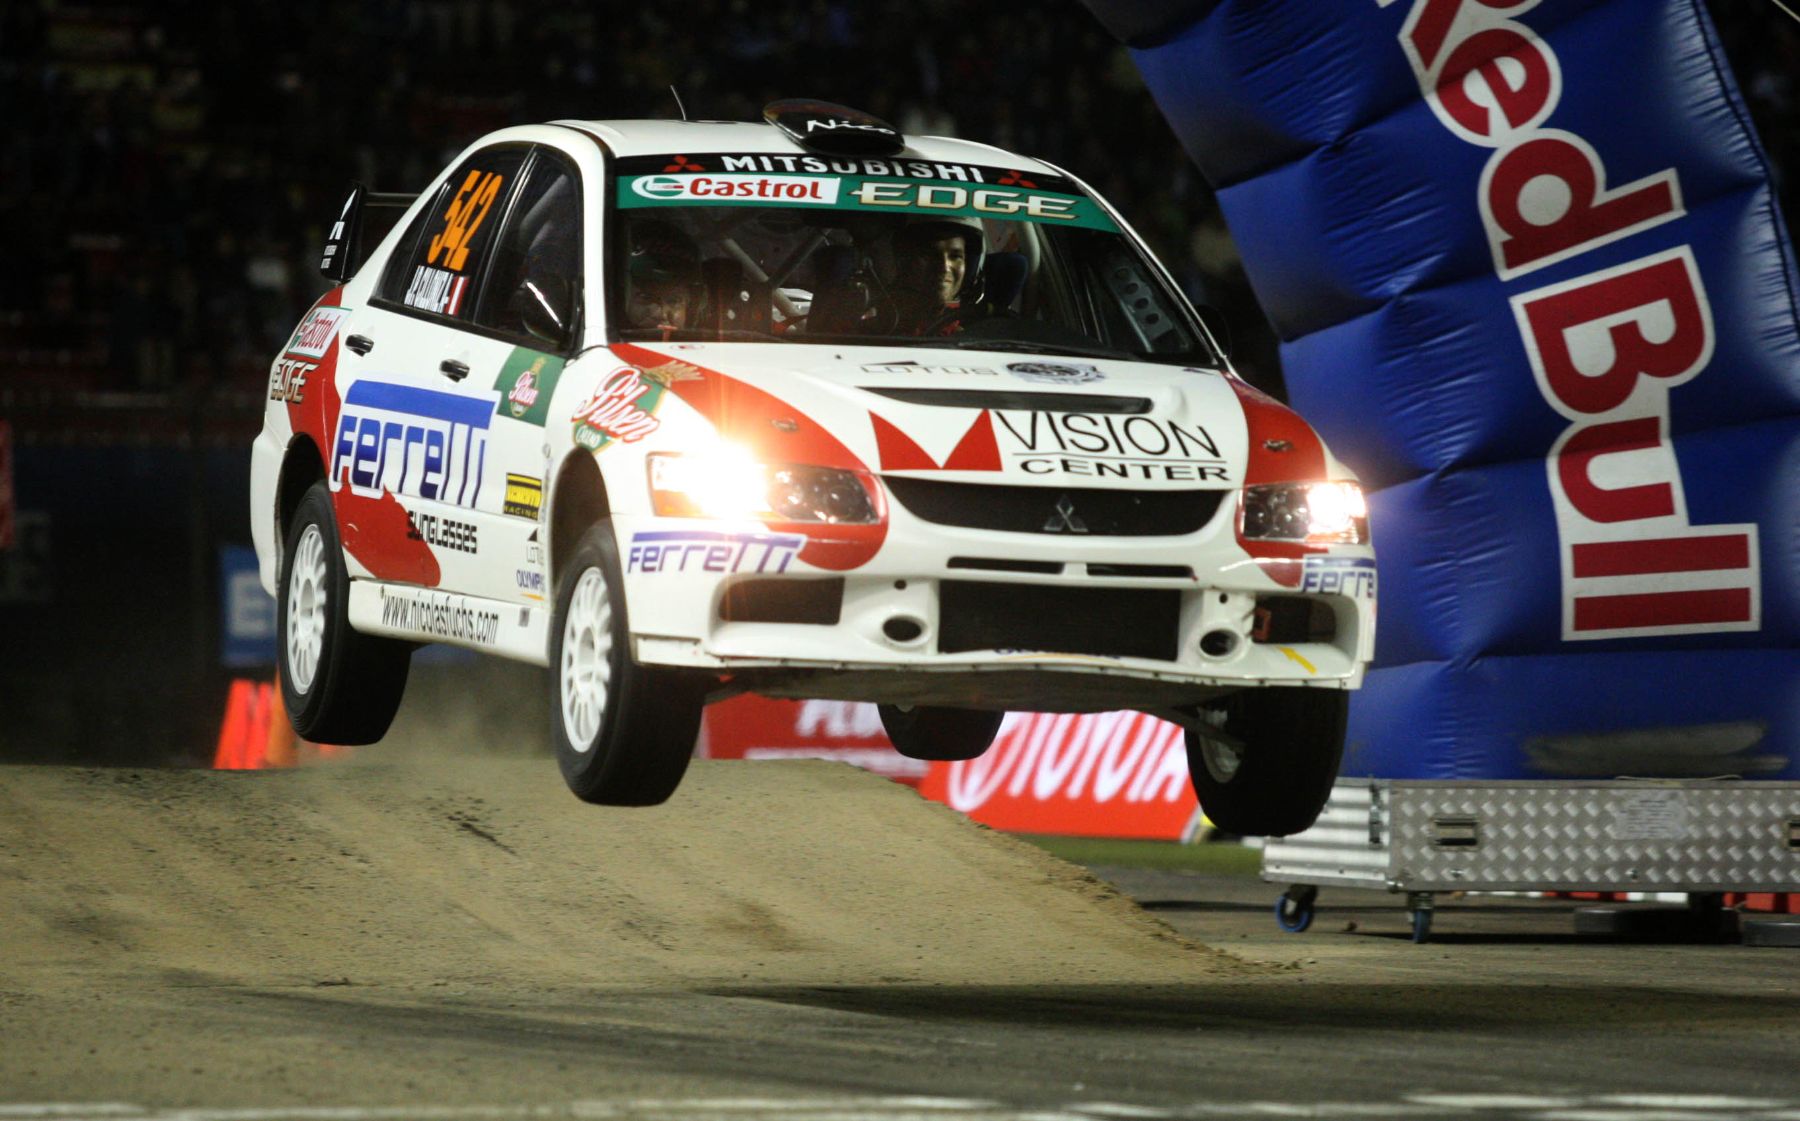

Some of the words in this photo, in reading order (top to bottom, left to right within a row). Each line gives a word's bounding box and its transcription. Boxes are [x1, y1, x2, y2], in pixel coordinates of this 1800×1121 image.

[720, 155, 985, 184] MITSUBISHI
[427, 169, 503, 271] 542
[689, 176, 823, 201] Castrol
[848, 181, 1081, 220] EDGE
[859, 364, 999, 376] LOTUS
[995, 411, 1222, 458] VISION
[1513, 248, 1758, 639] Bull
[1020, 458, 1232, 482] CENTER
[382, 590, 499, 644] www.nicolasfuchs.com
